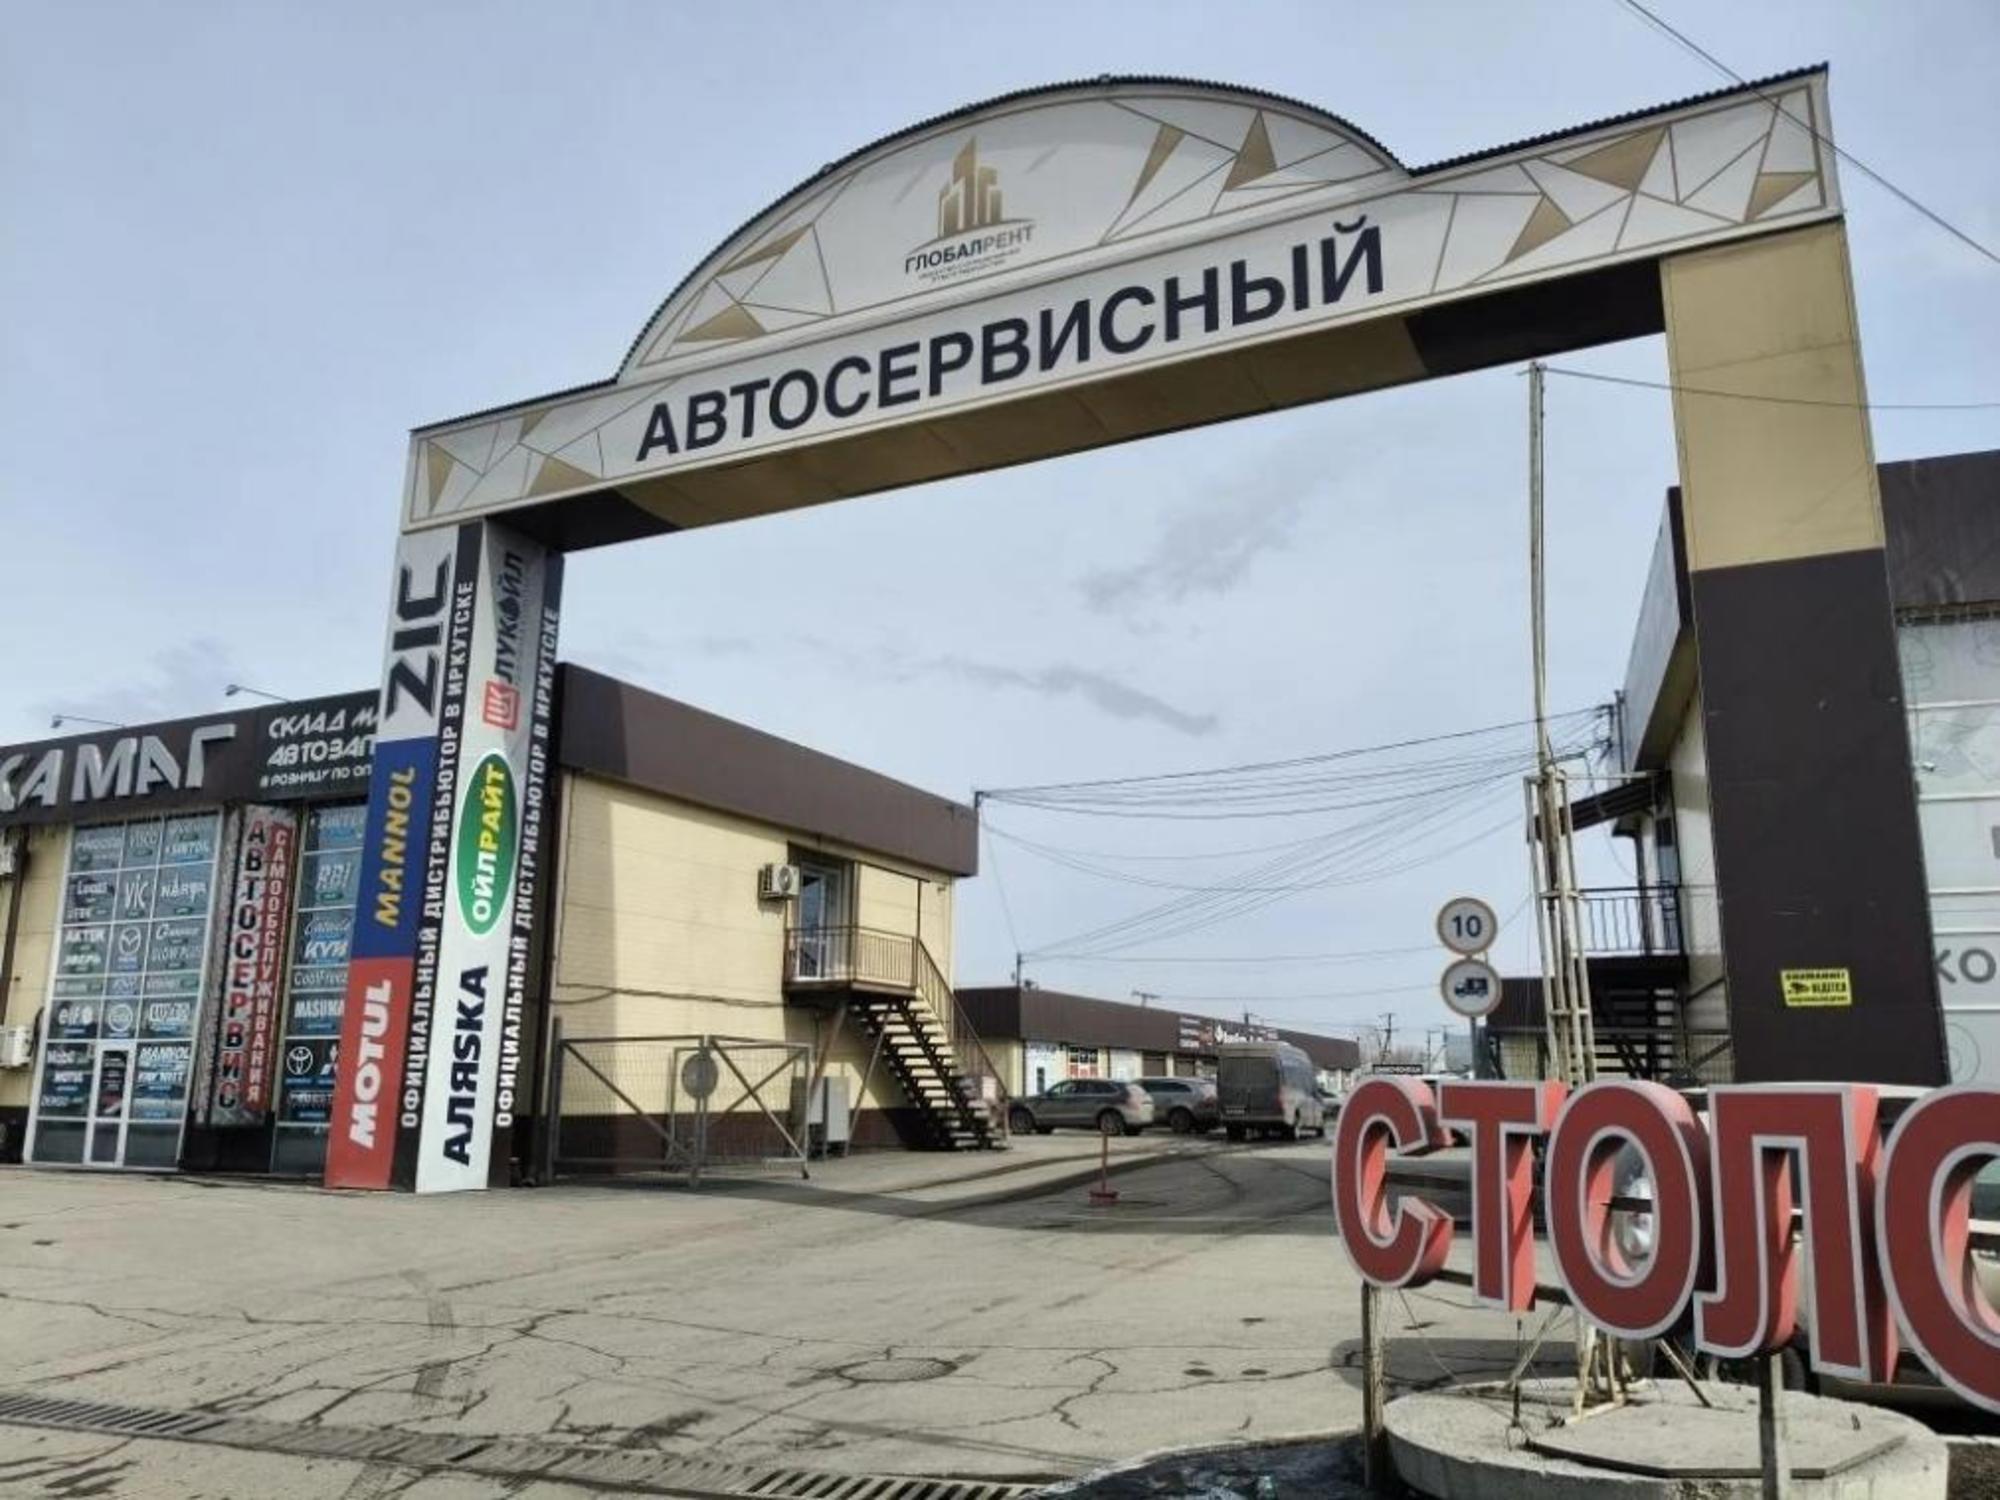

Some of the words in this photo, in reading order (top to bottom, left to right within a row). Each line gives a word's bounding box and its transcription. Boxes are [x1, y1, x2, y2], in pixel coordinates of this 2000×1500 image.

[905, 224, 1036, 274] ГЛОБАЛРЕНТ
[636, 215, 1384, 463] АВТОСЕРВИСНЫЙ
[385, 553, 450, 720] ZIC
[445, 703, 460, 718] В
[447, 581, 473, 696] ИРКУТСКЕ
[536, 609, 560, 717] ИРКУТСКЕ
[268, 708, 346, 739] СКЛАД
[533, 723, 549, 738] В
[375, 766, 416, 927] MANNOL
[423, 727, 458, 919] ДИСТРИБЬЮТОР
[471, 763, 505, 923] ОЙЛРАЙТ
[515, 744, 547, 929] ДИСТРИБЬЮТОР
[219, 821, 265, 1109] АВТОСЕРВИС
[1451, 914, 1482, 938] 10
[349, 979, 392, 1149] MOTUL
[401, 926, 438, 1128] ОФИЦИАЛЬНЫЙ
[496, 935, 528, 1127] ОФИЦИАЛЬНЫЙ
